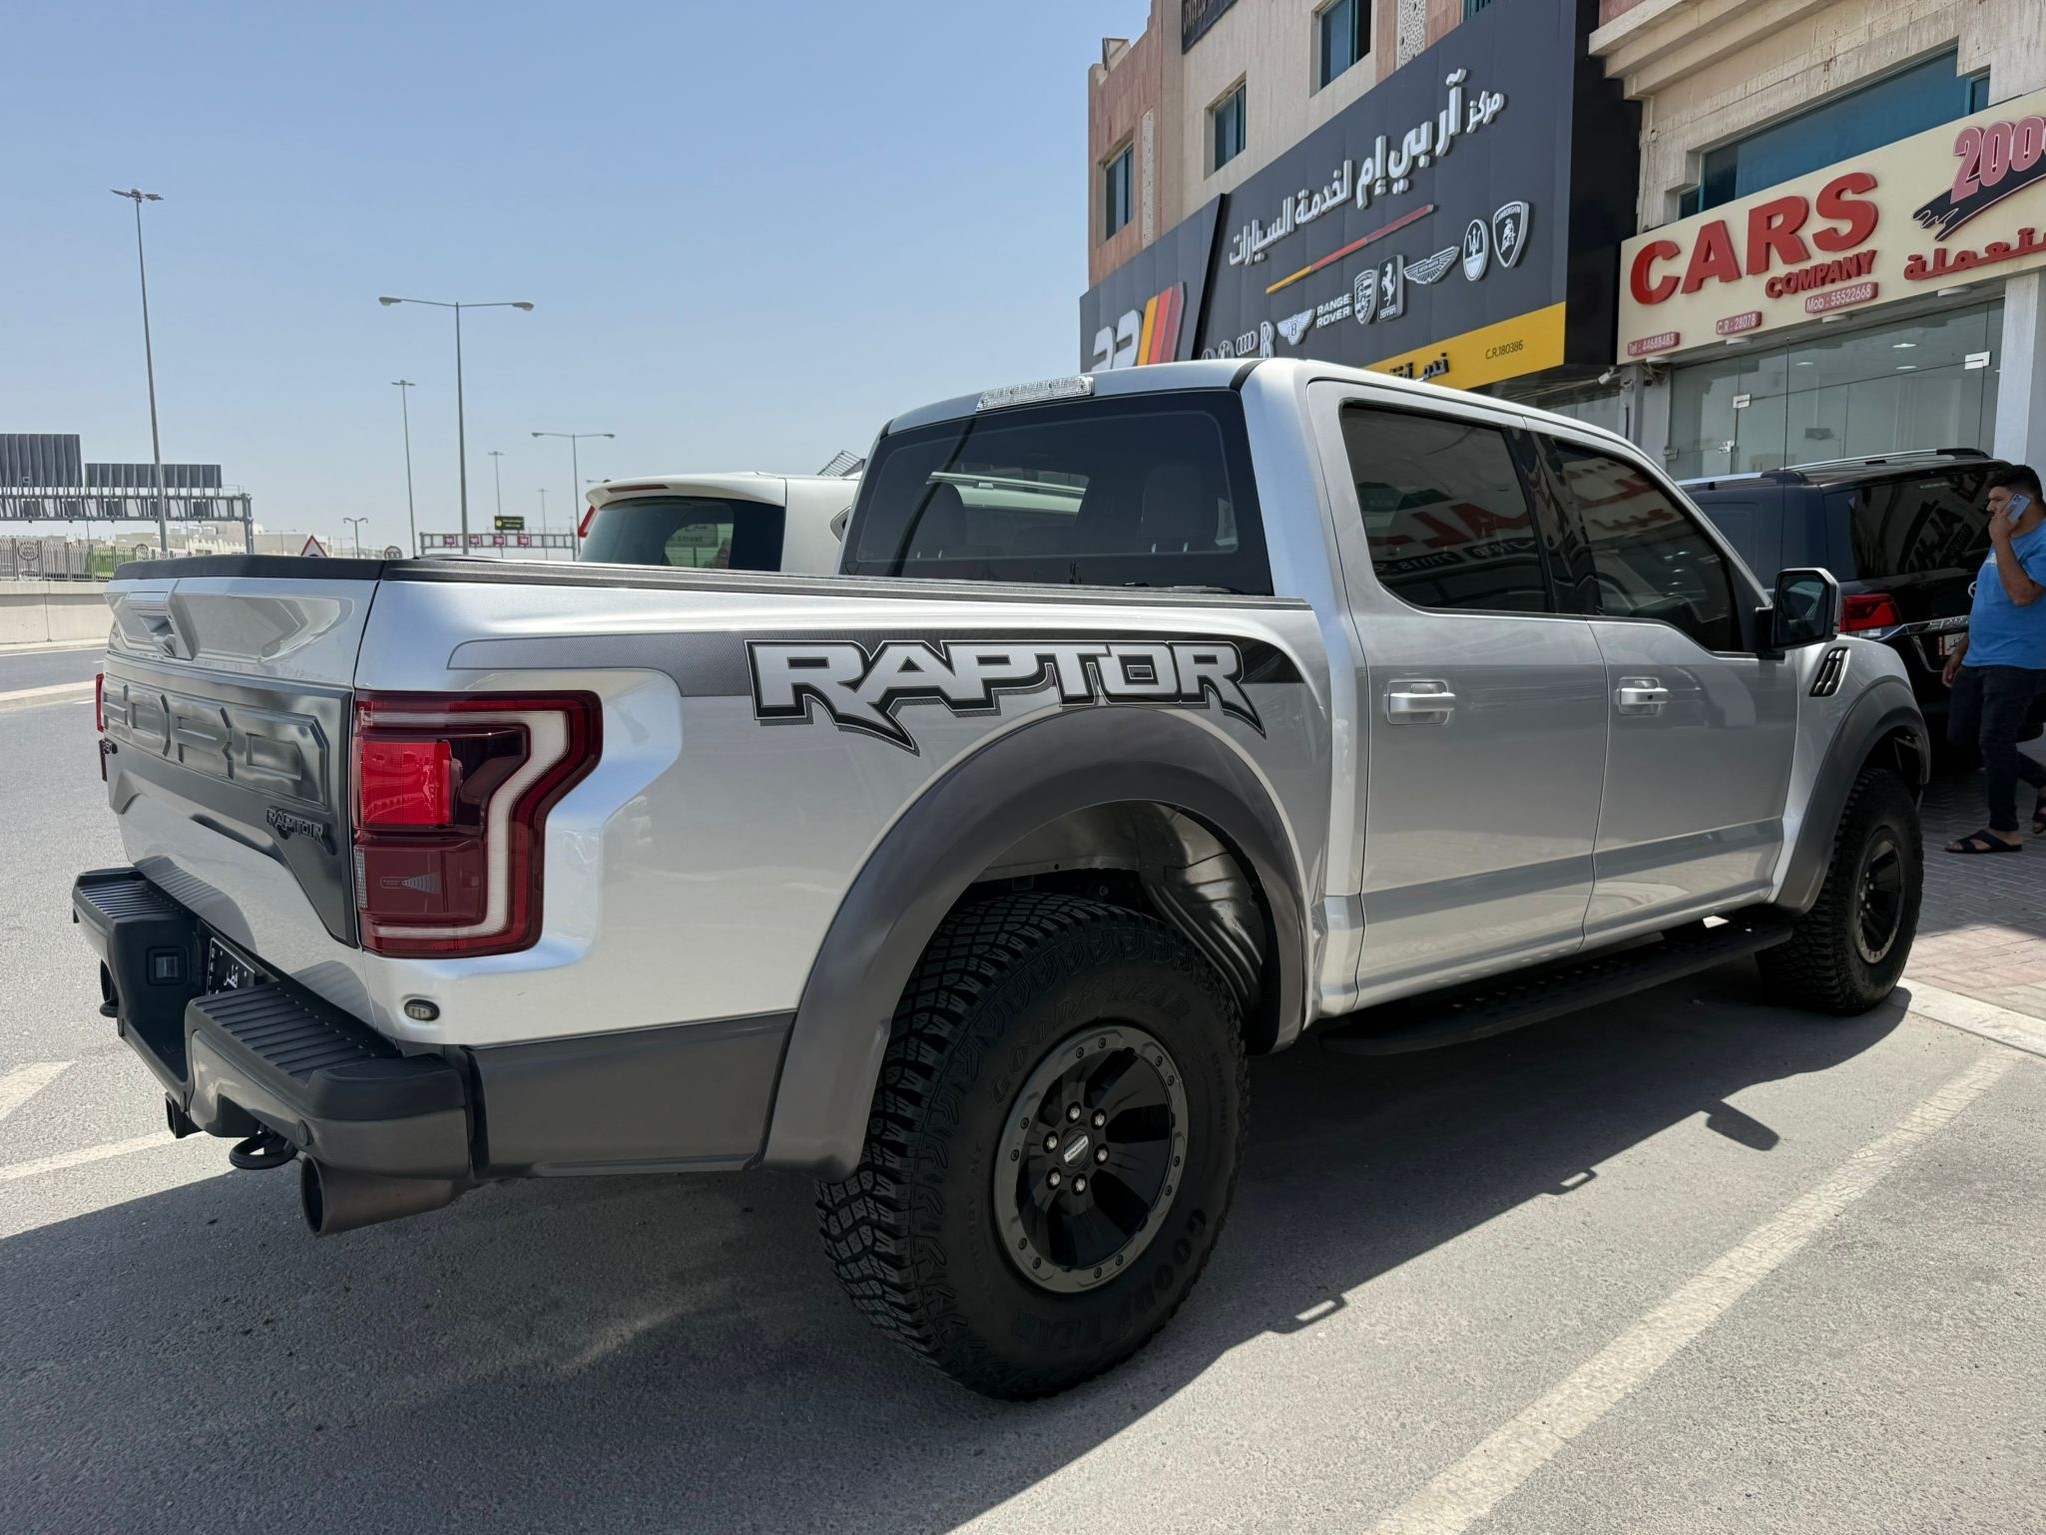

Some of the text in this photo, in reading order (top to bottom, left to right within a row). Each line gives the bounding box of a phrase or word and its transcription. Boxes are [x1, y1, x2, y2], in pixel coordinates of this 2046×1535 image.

[1229, 68, 1505, 266] مركز آر بي إم لخدمة السيارات
[1950, 116, 2046, 205] 200
[1630, 172, 1879, 305] CARS
[1316, 292, 1352, 316] RANGE
[1765, 250, 1878, 299] COMPANY
[1830, 283, 1872, 306] 55522668
[1316, 306, 1350, 329] ROVER
[745, 639, 1267, 756] RAPTOR
[101, 673, 330, 812] FORD
[265, 807, 330, 854] RAPTOR
